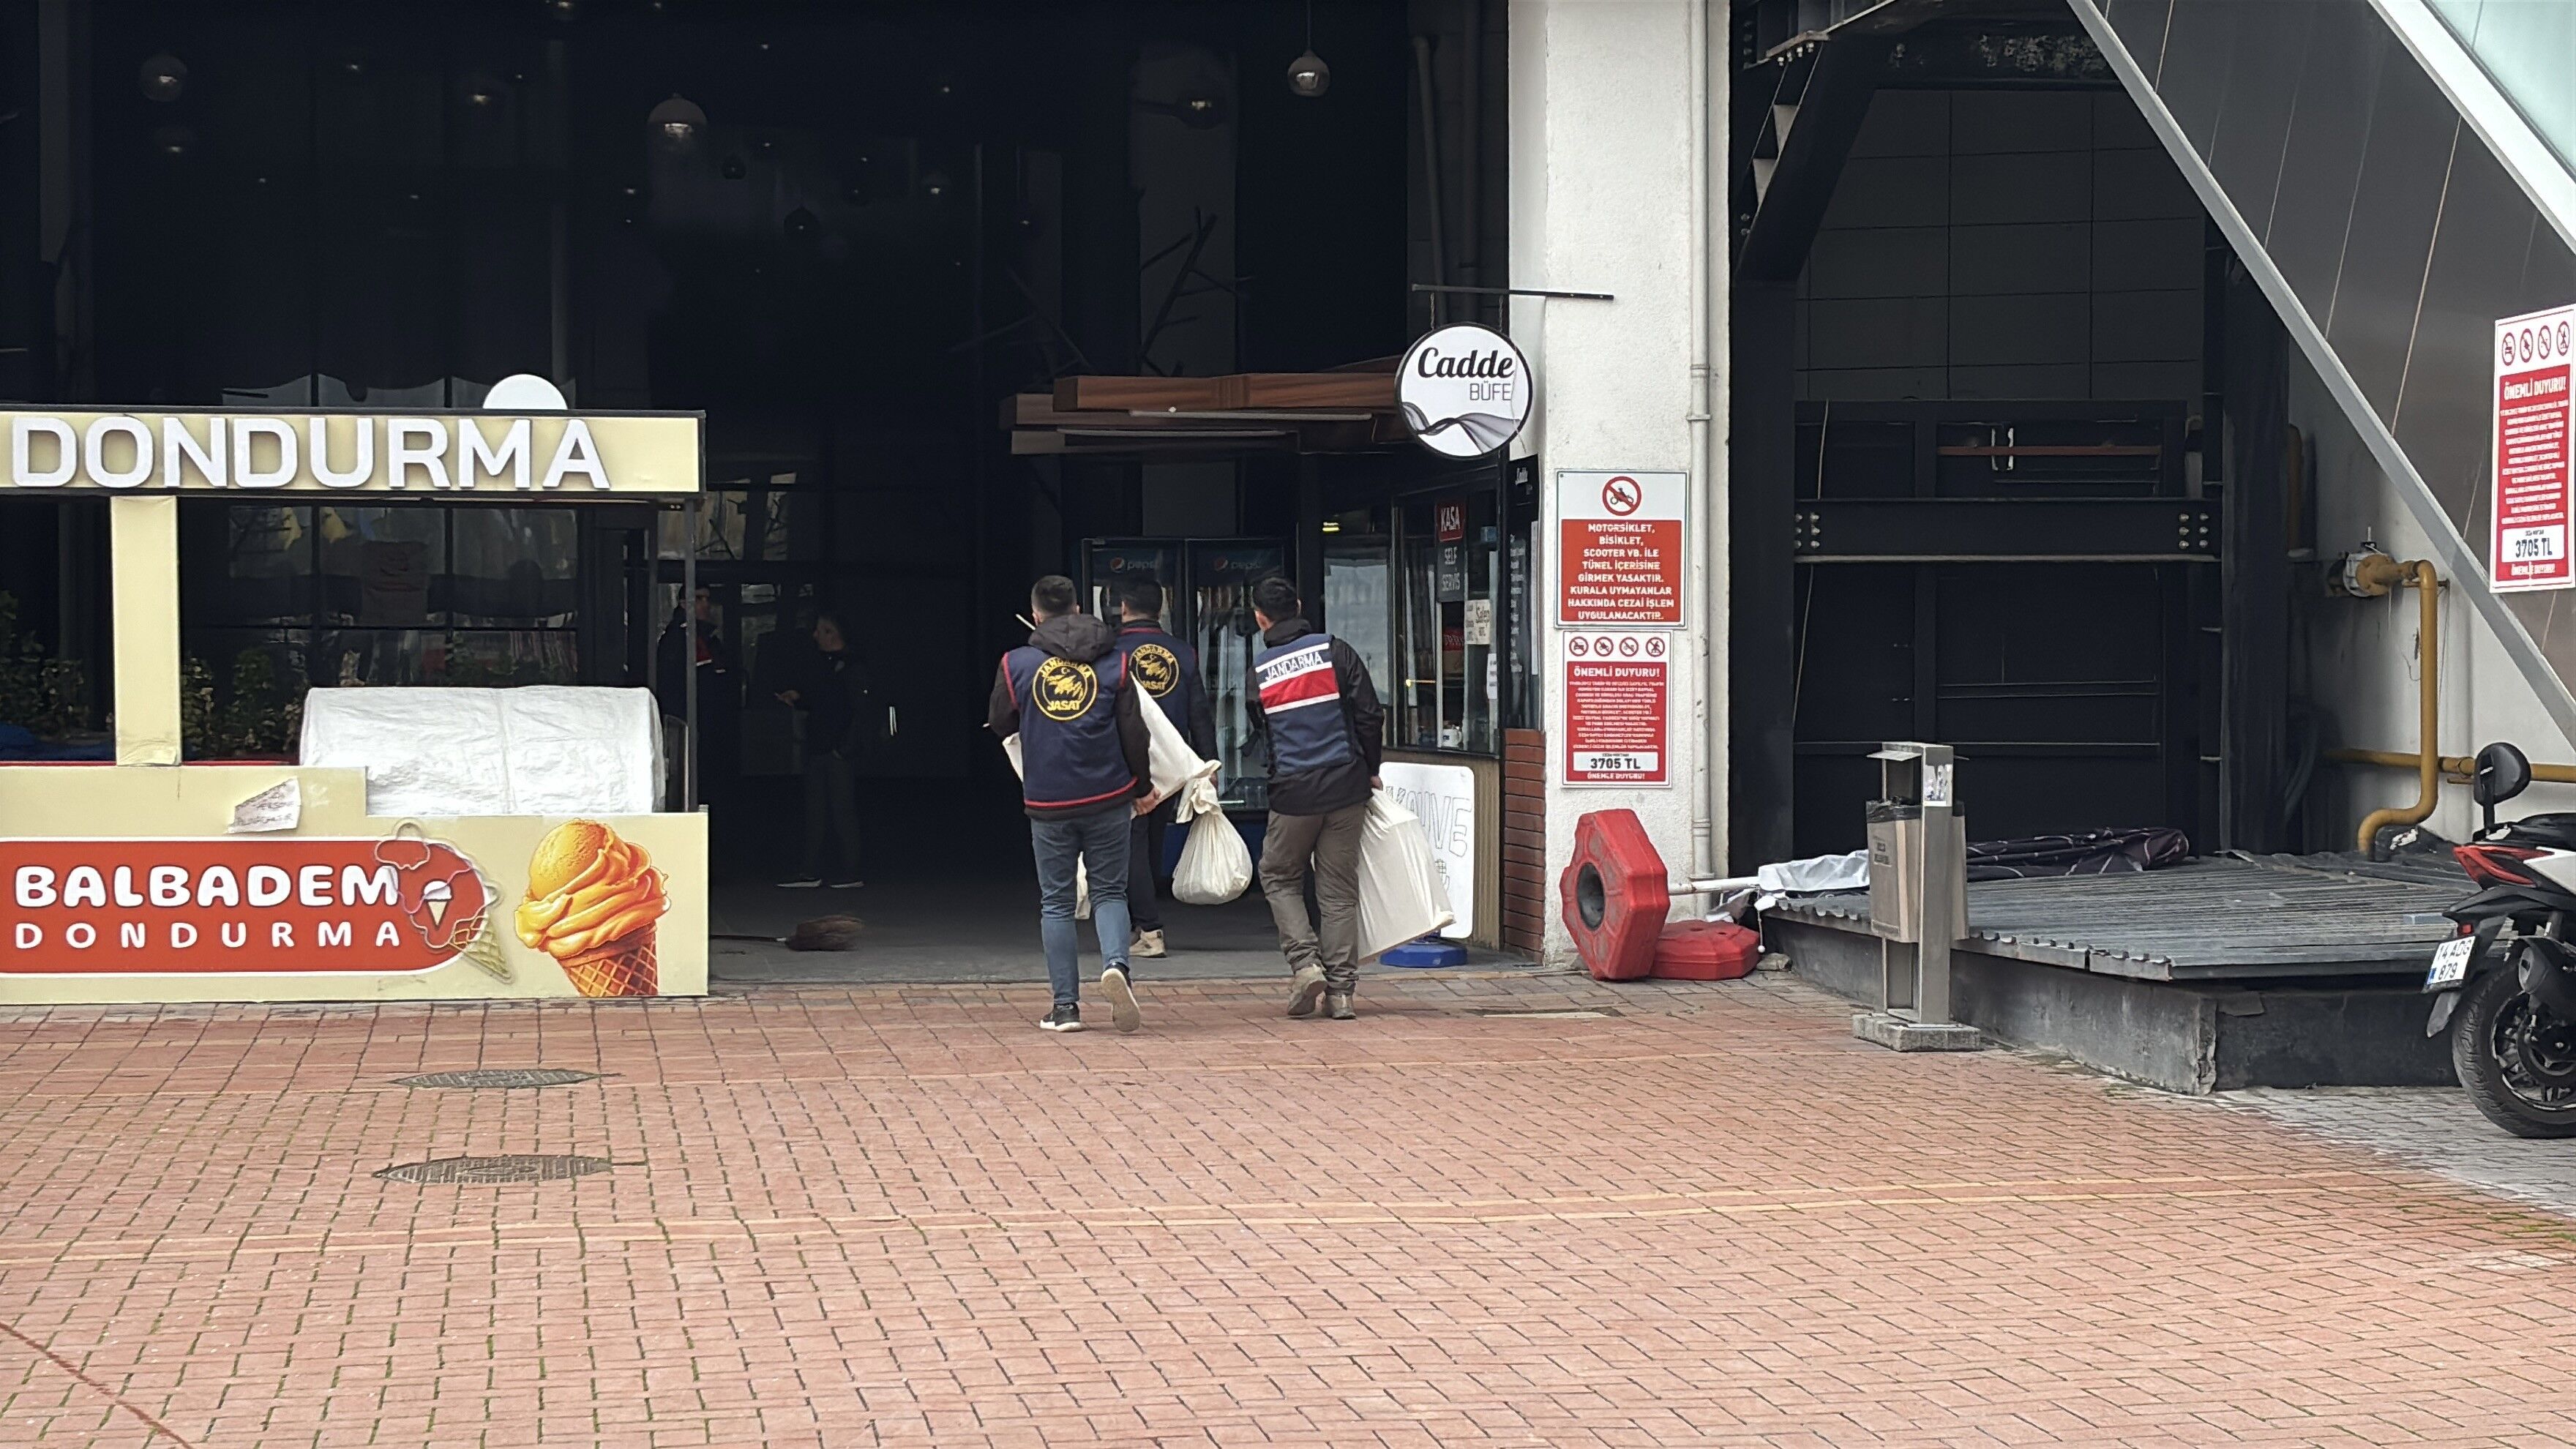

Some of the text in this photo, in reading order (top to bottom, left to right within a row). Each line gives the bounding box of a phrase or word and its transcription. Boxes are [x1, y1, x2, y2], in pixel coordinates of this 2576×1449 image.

[1418, 347, 1515, 378] Cadde
[1469, 381, 1511, 400] BÜFE
[12, 416, 611, 488] DONDURMA
[1440, 506, 1461, 532] KASA
[1588, 522, 1655, 533] MOTORSİKLET,
[1599, 535, 1644, 546] BİSİKLET,
[1584, 547, 1659, 557] SCOOTER VB. İLE
[2515, 538, 2553, 558] 3705 TL
[1582, 559, 1660, 571] TÜNEL İÇERİSİNE
[1578, 572, 1663, 583] GİRMEK YASAKTIR.
[1570, 586, 1672, 595] KURALA UYMAYANLAR
[1568, 597, 1674, 609] HAKKINDA CEZAİ İŞLEM
[1265, 652, 1323, 681] JANDARMA
[1574, 666, 1660, 678] ÖNEMLİ DUYURU!
[1046, 700, 1081, 711] JASAT
[1590, 758, 1641, 769] 3705 TL
[15, 865, 398, 907] BALBADEM
[15, 921, 400, 948] DONDURMA
[2438, 962, 2458, 980] 879
